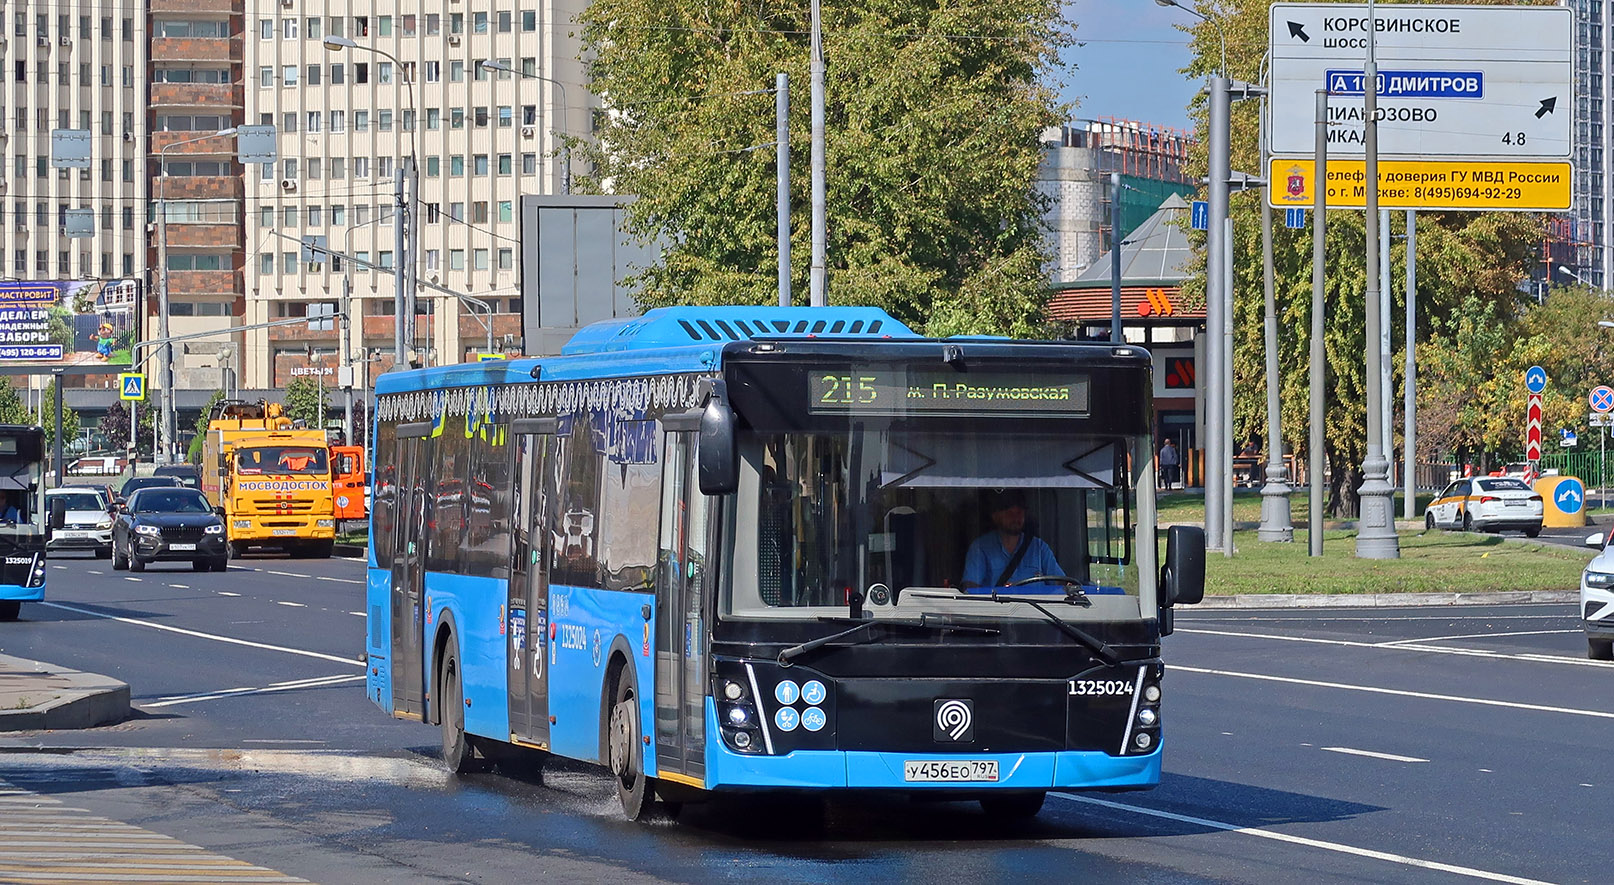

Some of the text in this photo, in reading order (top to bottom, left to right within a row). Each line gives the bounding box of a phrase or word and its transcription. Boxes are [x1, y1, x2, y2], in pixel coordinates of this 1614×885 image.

[1324, 38, 1378, 48] шосс
[1334, 76, 1347, 91] А
[1388, 77, 1478, 94] ДМИТРОВ
[1501, 131, 1526, 146] 4.8
[1385, 172, 1446, 184] доверия
[1451, 171, 1468, 182] ГУ
[1472, 171, 1504, 184] МВД
[1508, 172, 1560, 183] России
[1340, 188, 1348, 197] г.
[1353, 186, 1409, 198] Мкве:
[1414, 187, 1521, 201] 8(495)694-92-29
[0, 311, 49, 322] ДЕЛАЕМ
[0, 323, 49, 331] НАДЕЖНЫЕ
[0, 332, 49, 342] ЗАБОРЫ
[20, 348, 60, 356] 120-66-99
[820, 375, 877, 403] 215
[239, 481, 329, 491] МОСВОДОСТОК
[5, 557, 32, 565] 1325019
[561, 624, 587, 650] 1325024
[1068, 680, 1134, 696] 1325024
